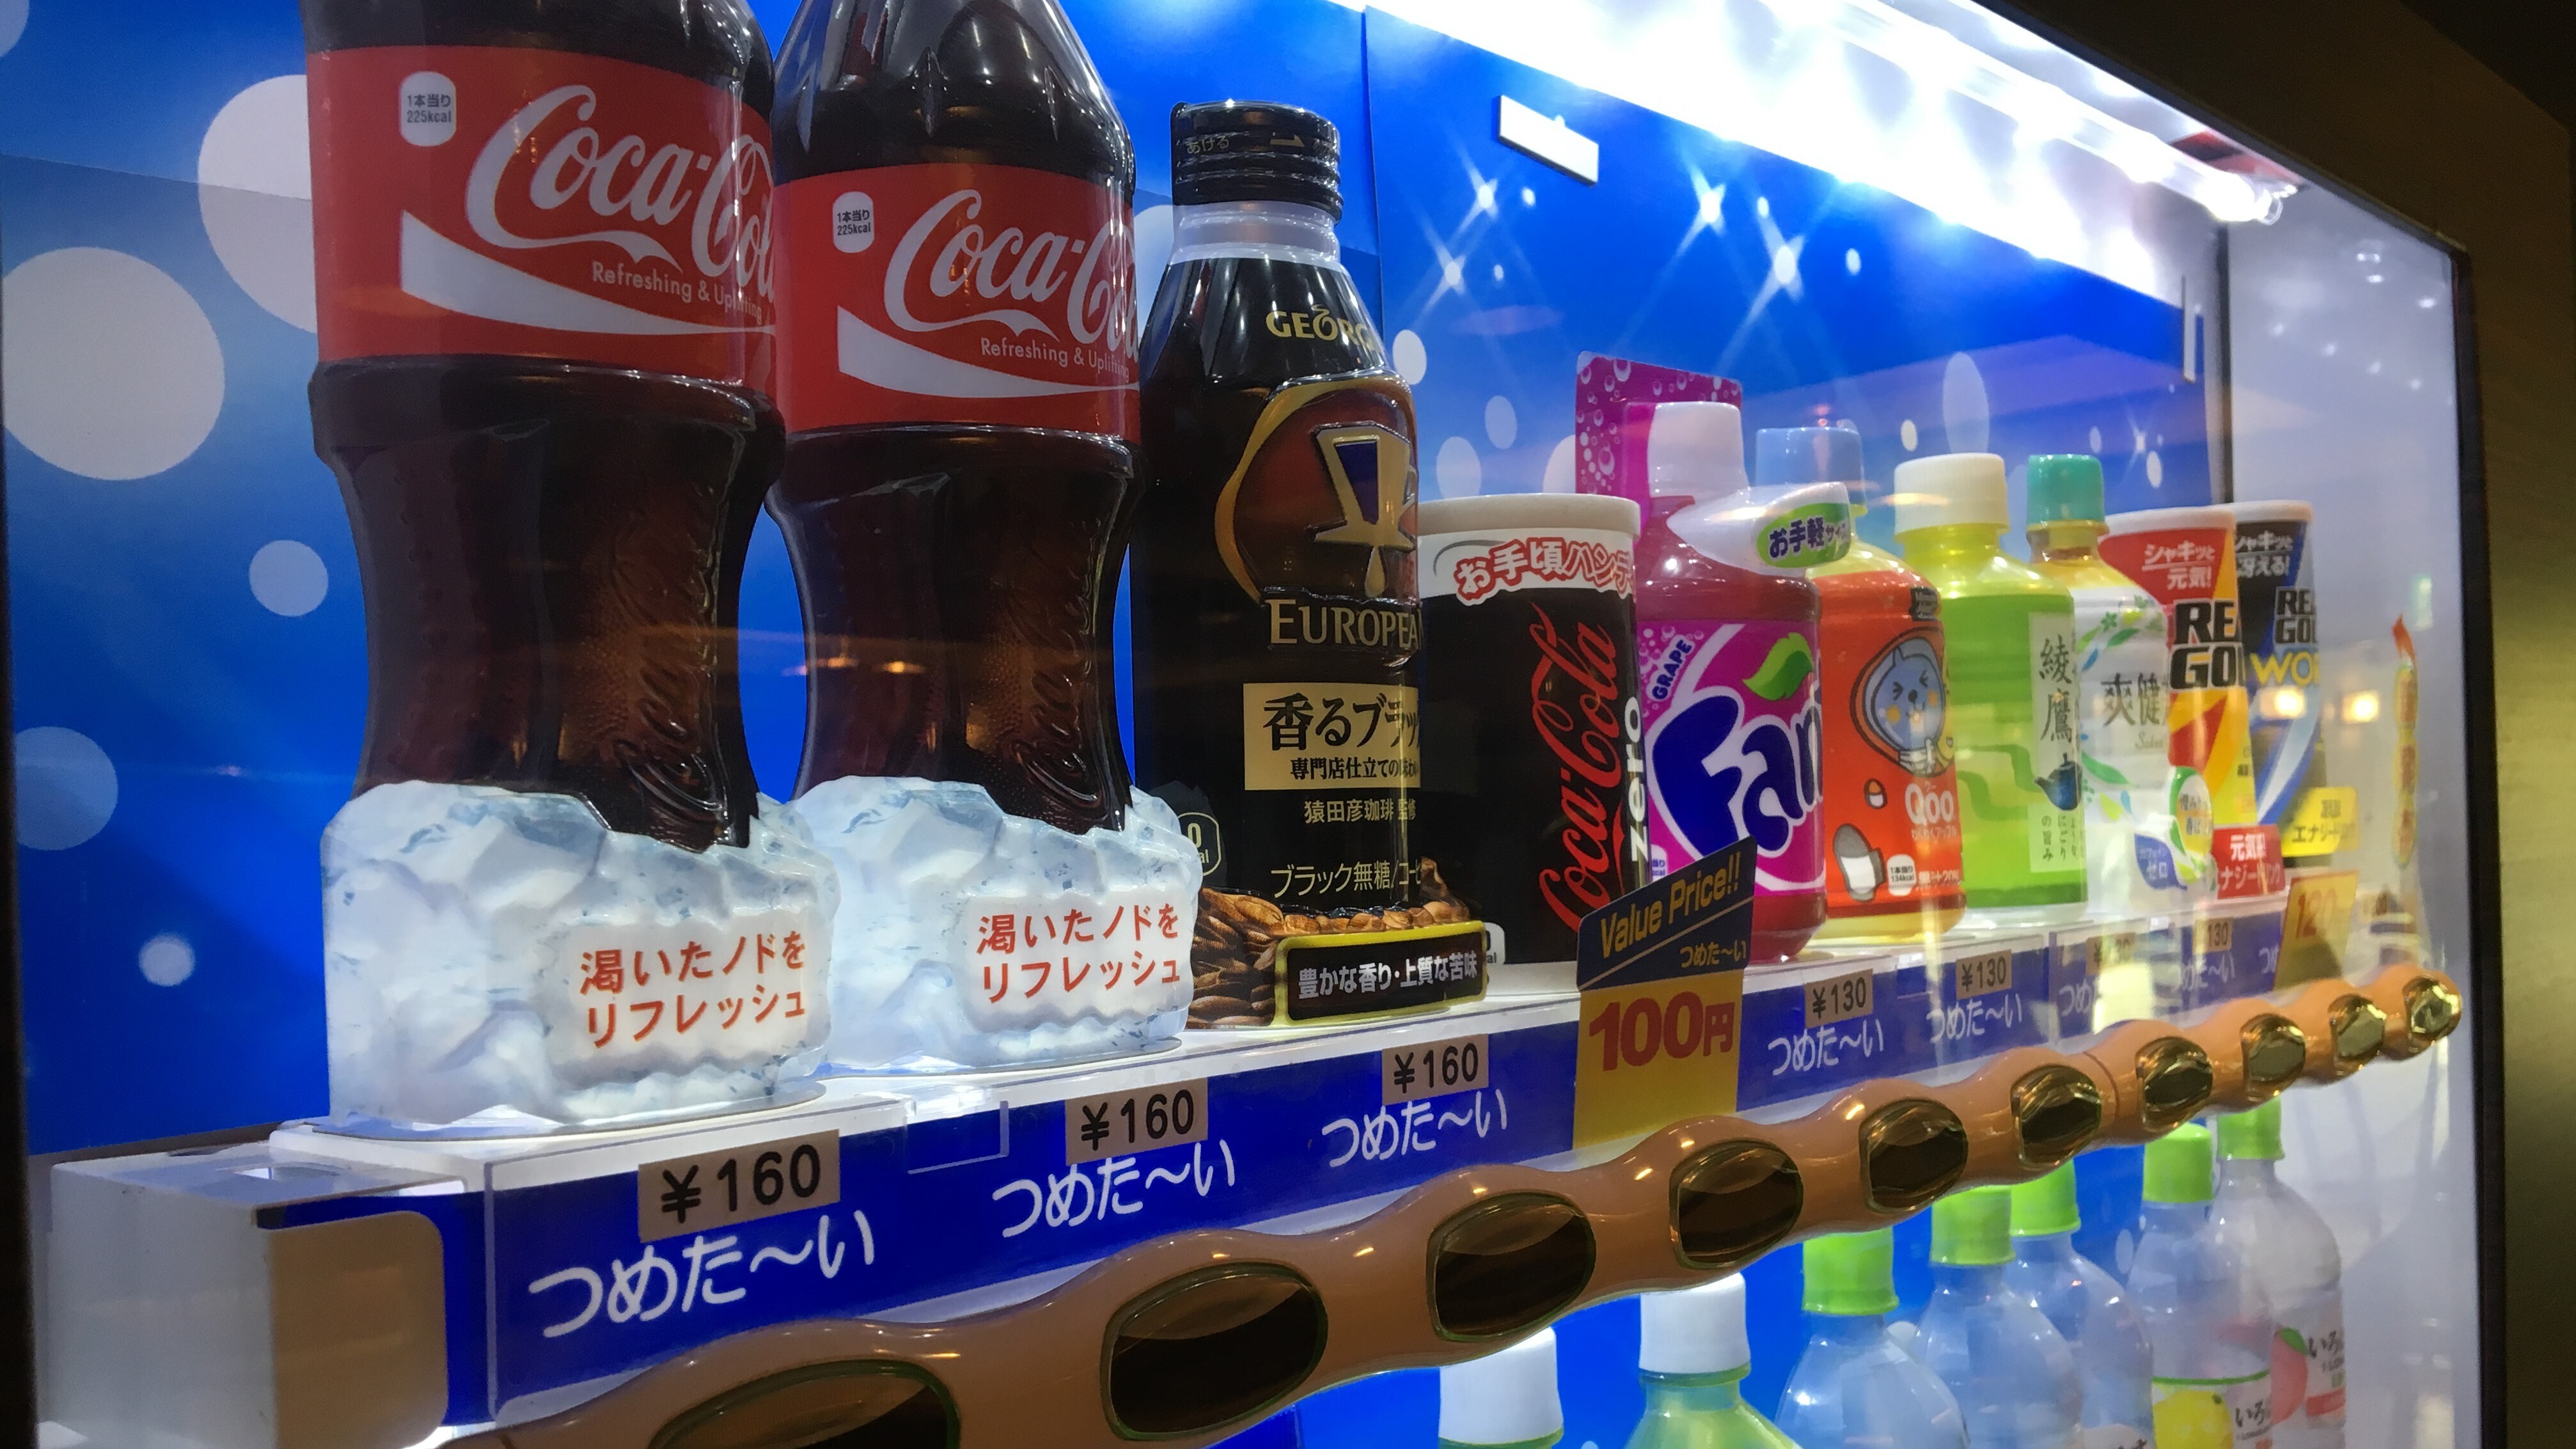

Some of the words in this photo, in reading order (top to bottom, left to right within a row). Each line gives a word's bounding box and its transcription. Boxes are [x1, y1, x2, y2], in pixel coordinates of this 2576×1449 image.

[406, 93, 452, 108] 1本当り
[406, 109, 452, 125] 225kcal
[1186, 135, 1230, 155] あける
[836, 209, 870, 223] 1本当り
[836, 222, 871, 236] 225kcal
[592, 261, 692, 304] Refreshing
[698, 281, 711, 301] &
[981, 337, 1069, 368] Refreshing
[1074, 347, 1085, 365] &
[1088, 351, 1129, 383] Uplifting
[2144, 540, 2215, 564] シャキッと
[2167, 566, 2212, 590] 元気!
[1651, 639, 1694, 701] GRAPE
[2039, 632, 2073, 744] 綾鷹
[1263, 692, 1419, 751] 香るブラッ
[1624, 696, 1650, 862] zero
[1651, 691, 1823, 853] Fan
[1303, 797, 1395, 824] 猿田彦珈琲
[1905, 783, 1955, 826] Qoo
[976, 904, 1180, 953] 渇いたノドを
[1600, 905, 1662, 959] Value
[1669, 850, 1742, 925] Price!!
[579, 930, 806, 994] 渇いたノドを
[982, 953, 1181, 1004] リフレッシュ
[1298, 951, 1479, 999] 豊かな香り・上質な苦味
[1961, 958, 2007, 992] ¥130
[586, 983, 806, 1048] リフレッシュ
[1812, 981, 1867, 1019] ¥130
[1588, 991, 1736, 1072] 100円
[1393, 1042, 1479, 1093] ¥160
[1080, 1088, 1195, 1150] ¥160
[660, 1144, 821, 1224] ¥160
